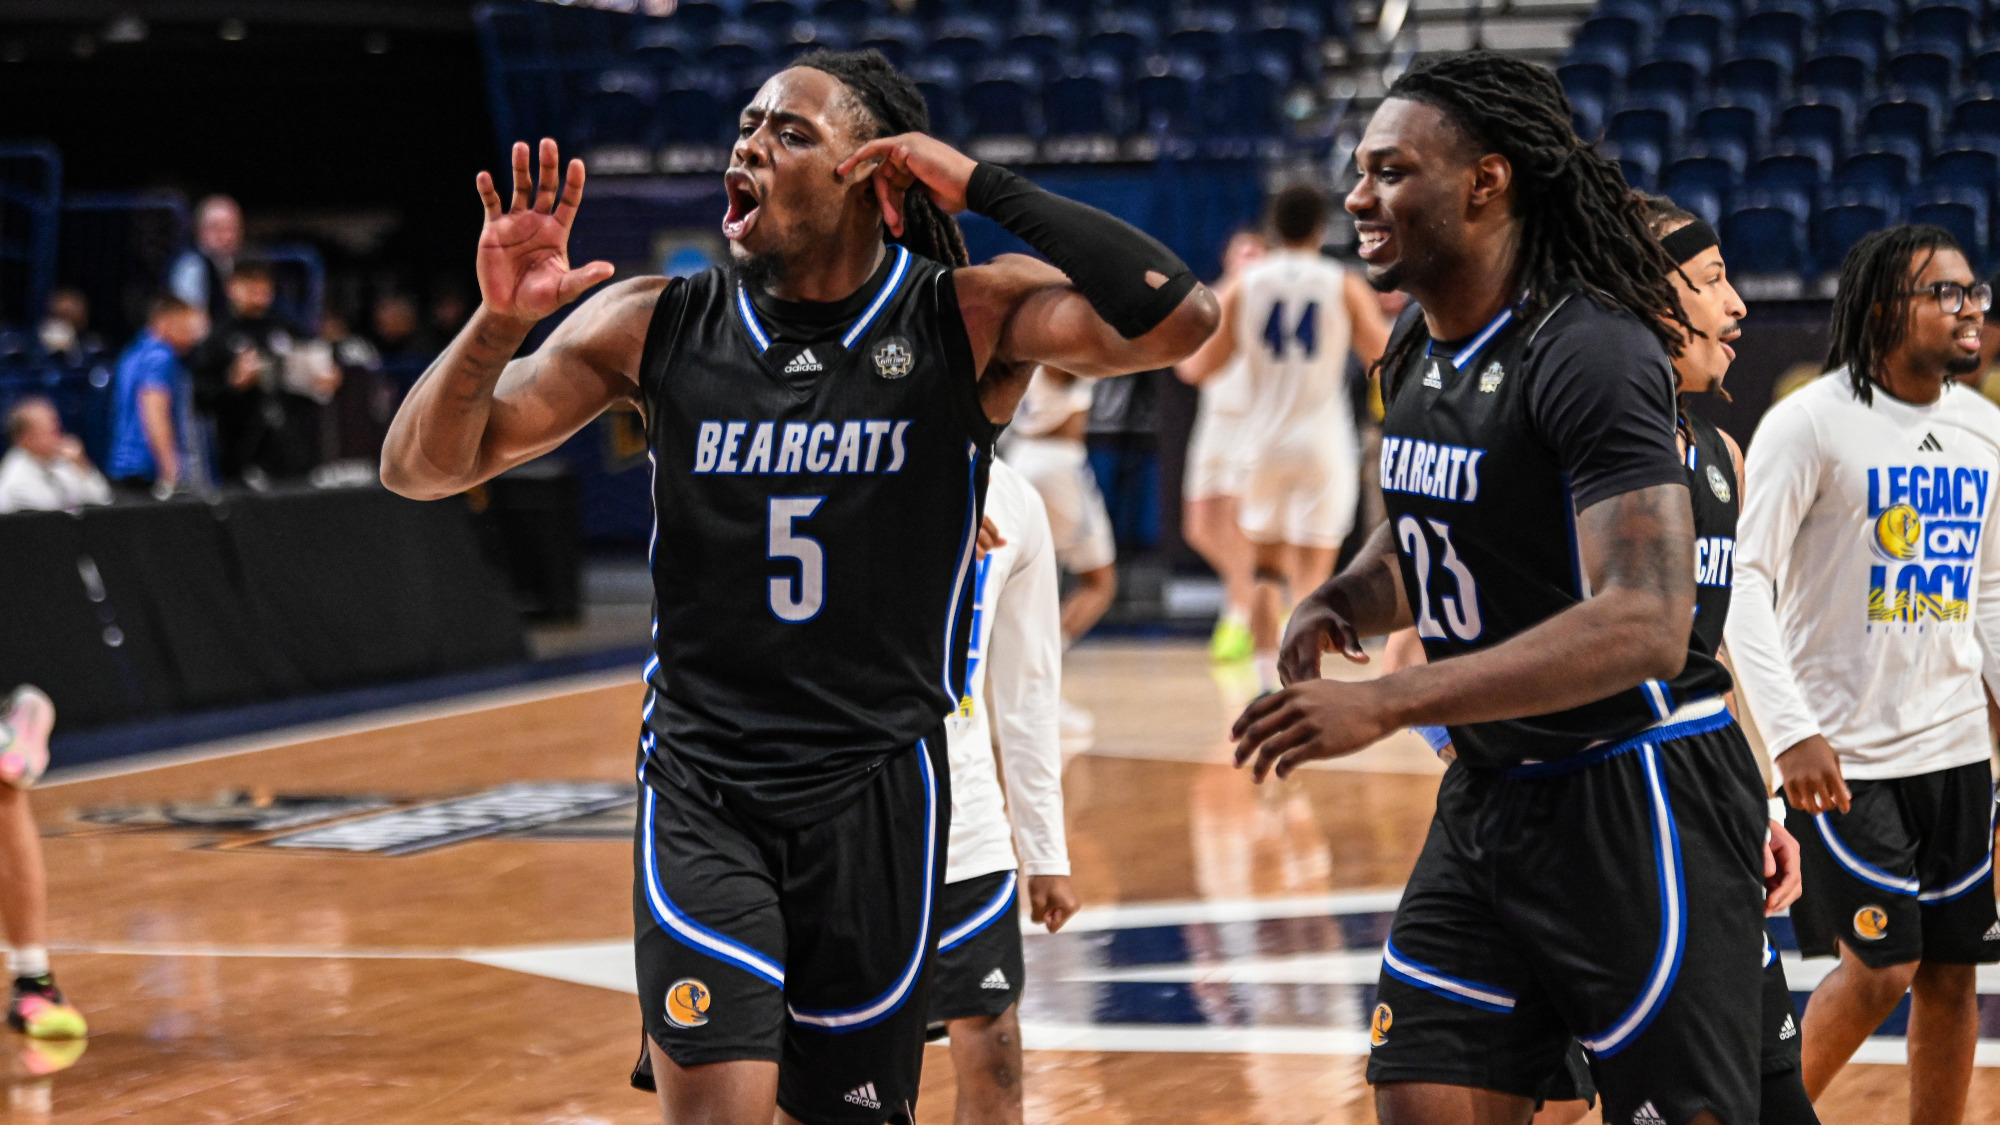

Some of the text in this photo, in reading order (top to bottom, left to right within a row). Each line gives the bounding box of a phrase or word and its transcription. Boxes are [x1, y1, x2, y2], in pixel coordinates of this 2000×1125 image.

[1261, 299, 1319, 360] 44
[785, 363, 823, 373] adidas
[692, 420, 914, 474] BEARCATS
[1868, 466, 1988, 519] LEGACY
[766, 495, 827, 624] 5
[1928, 528, 1976, 554] ON
[1397, 514, 1484, 643] 23
[1868, 565, 1973, 623] LOCK
[844, 1094, 881, 1109] adidas
